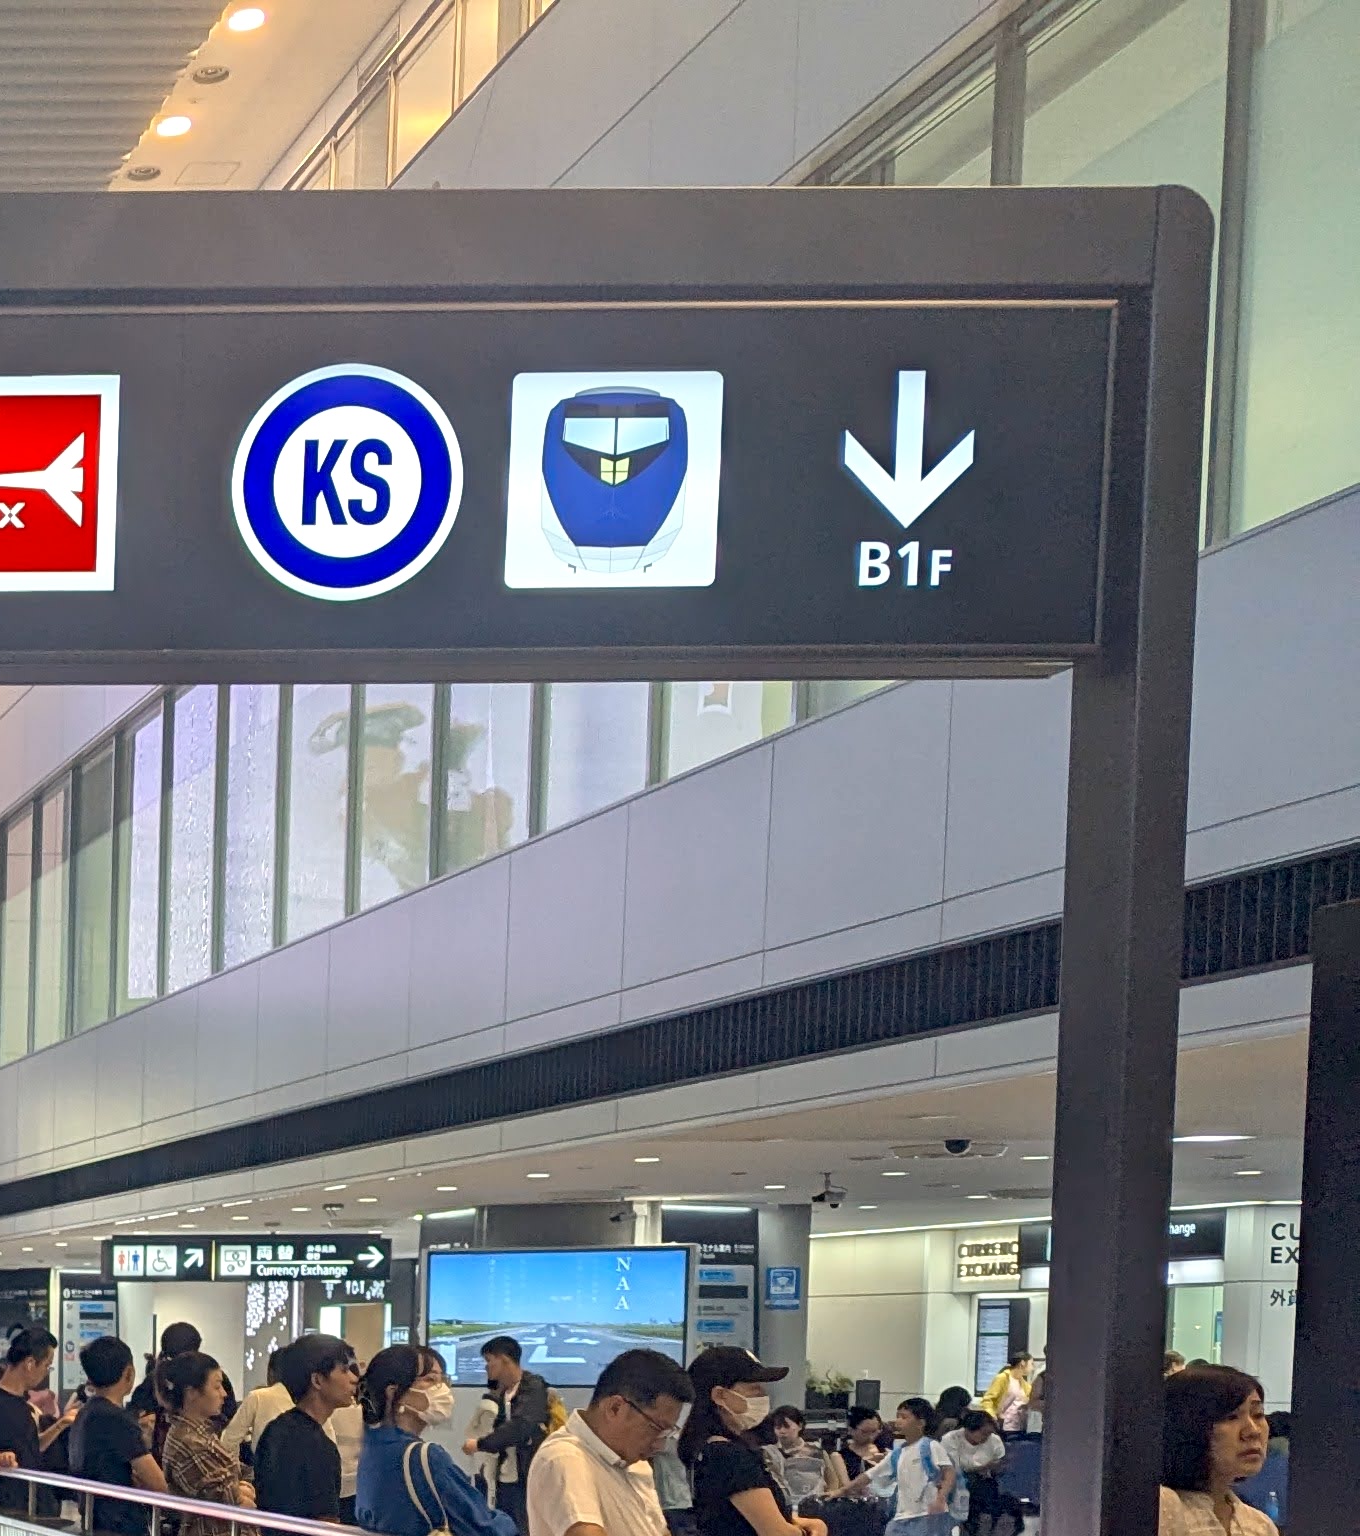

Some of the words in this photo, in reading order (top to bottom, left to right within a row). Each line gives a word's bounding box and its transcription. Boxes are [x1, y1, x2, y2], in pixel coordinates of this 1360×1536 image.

[300, 438, 394, 528] KS
[856, 541, 954, 588] B1F
[1169, 1222, 1196, 1237] hange
[1271, 1222, 1300, 1240] CU
[1270, 1246, 1299, 1264] EX
[256, 1265, 300, 1278] Currency
[300, 1265, 349, 1278] Exchange
